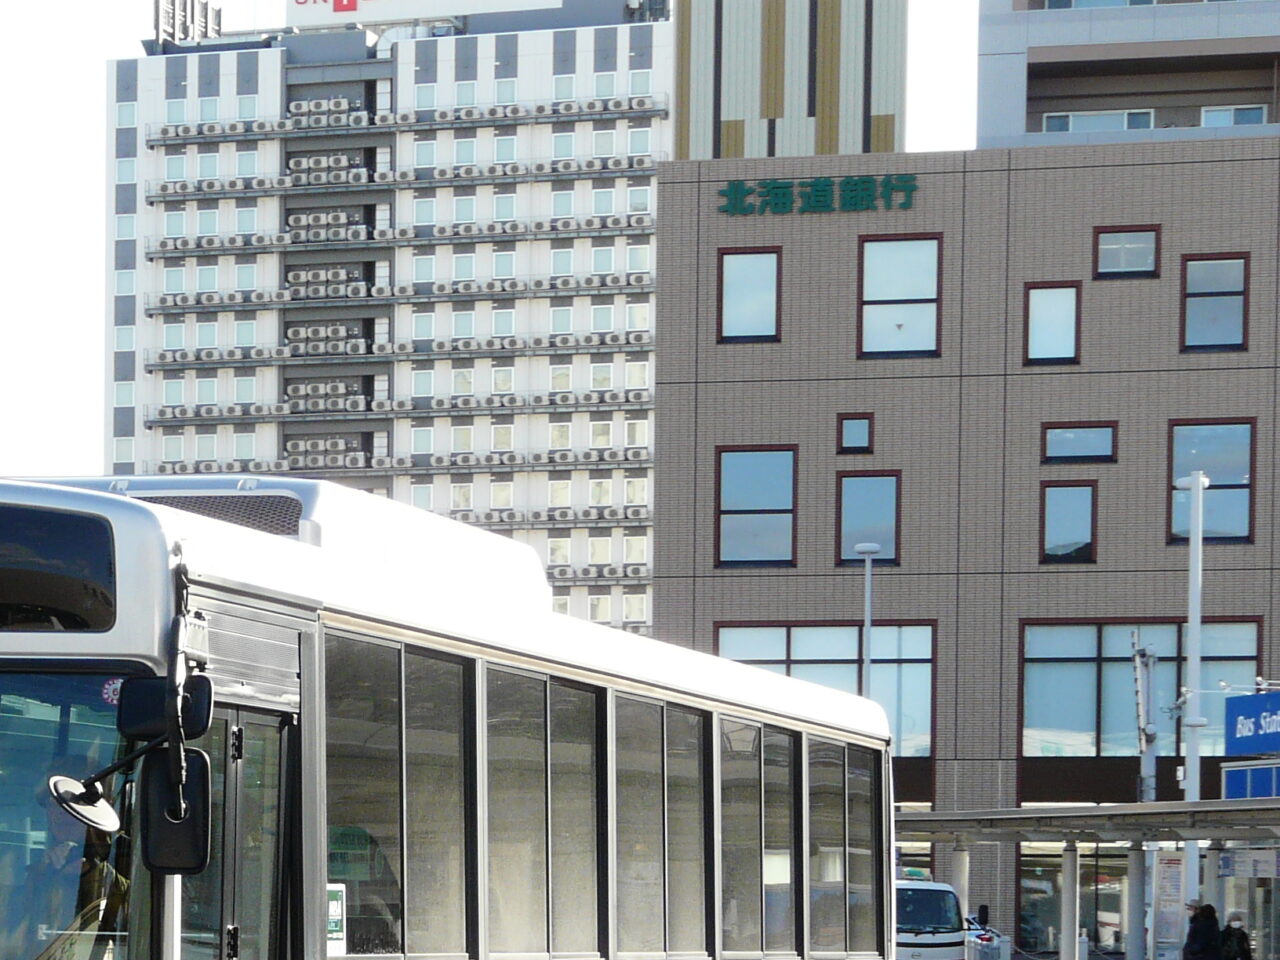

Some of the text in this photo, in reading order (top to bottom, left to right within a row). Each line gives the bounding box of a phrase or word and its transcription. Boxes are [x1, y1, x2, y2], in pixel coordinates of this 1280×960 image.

[718, 175, 919, 216] 北海道銀行
[1236, 715, 1255, 738] Bus
